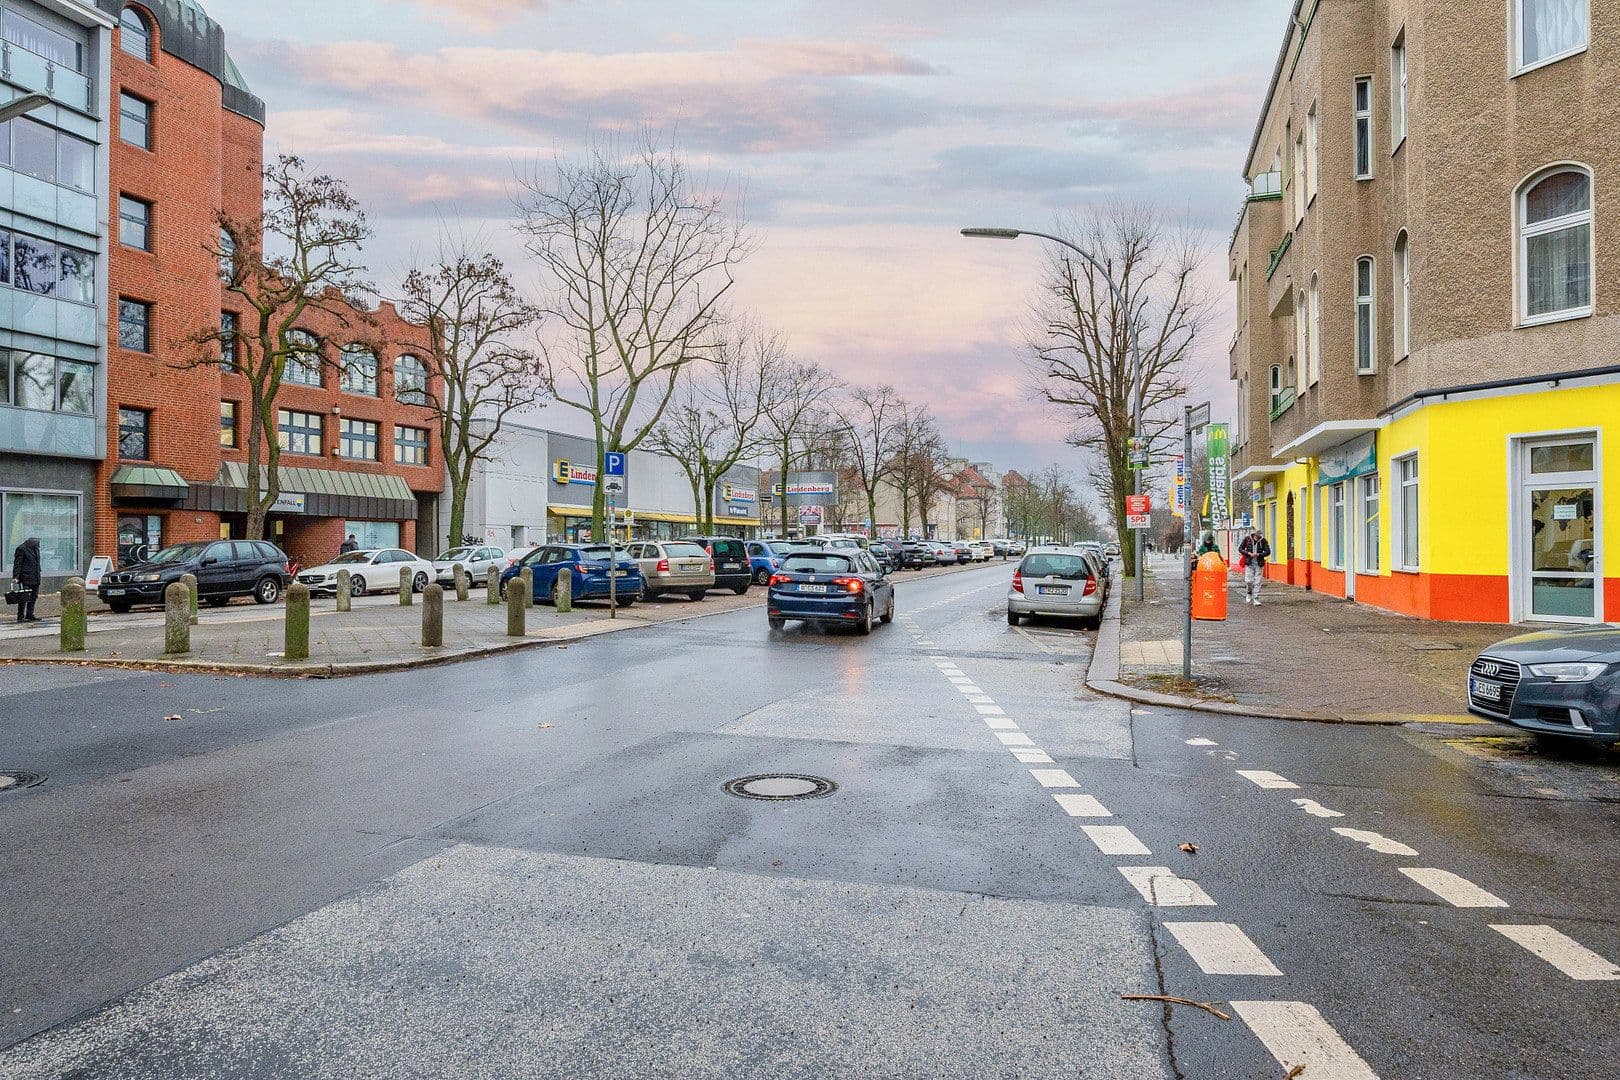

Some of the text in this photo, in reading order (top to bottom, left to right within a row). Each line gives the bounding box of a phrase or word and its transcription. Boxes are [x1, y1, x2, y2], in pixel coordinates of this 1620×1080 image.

[609, 455, 620, 472] P
[571, 468, 597, 480] Linden
[787, 485, 830, 493] Lindenberg
[1130, 515, 1147, 523] SPD
